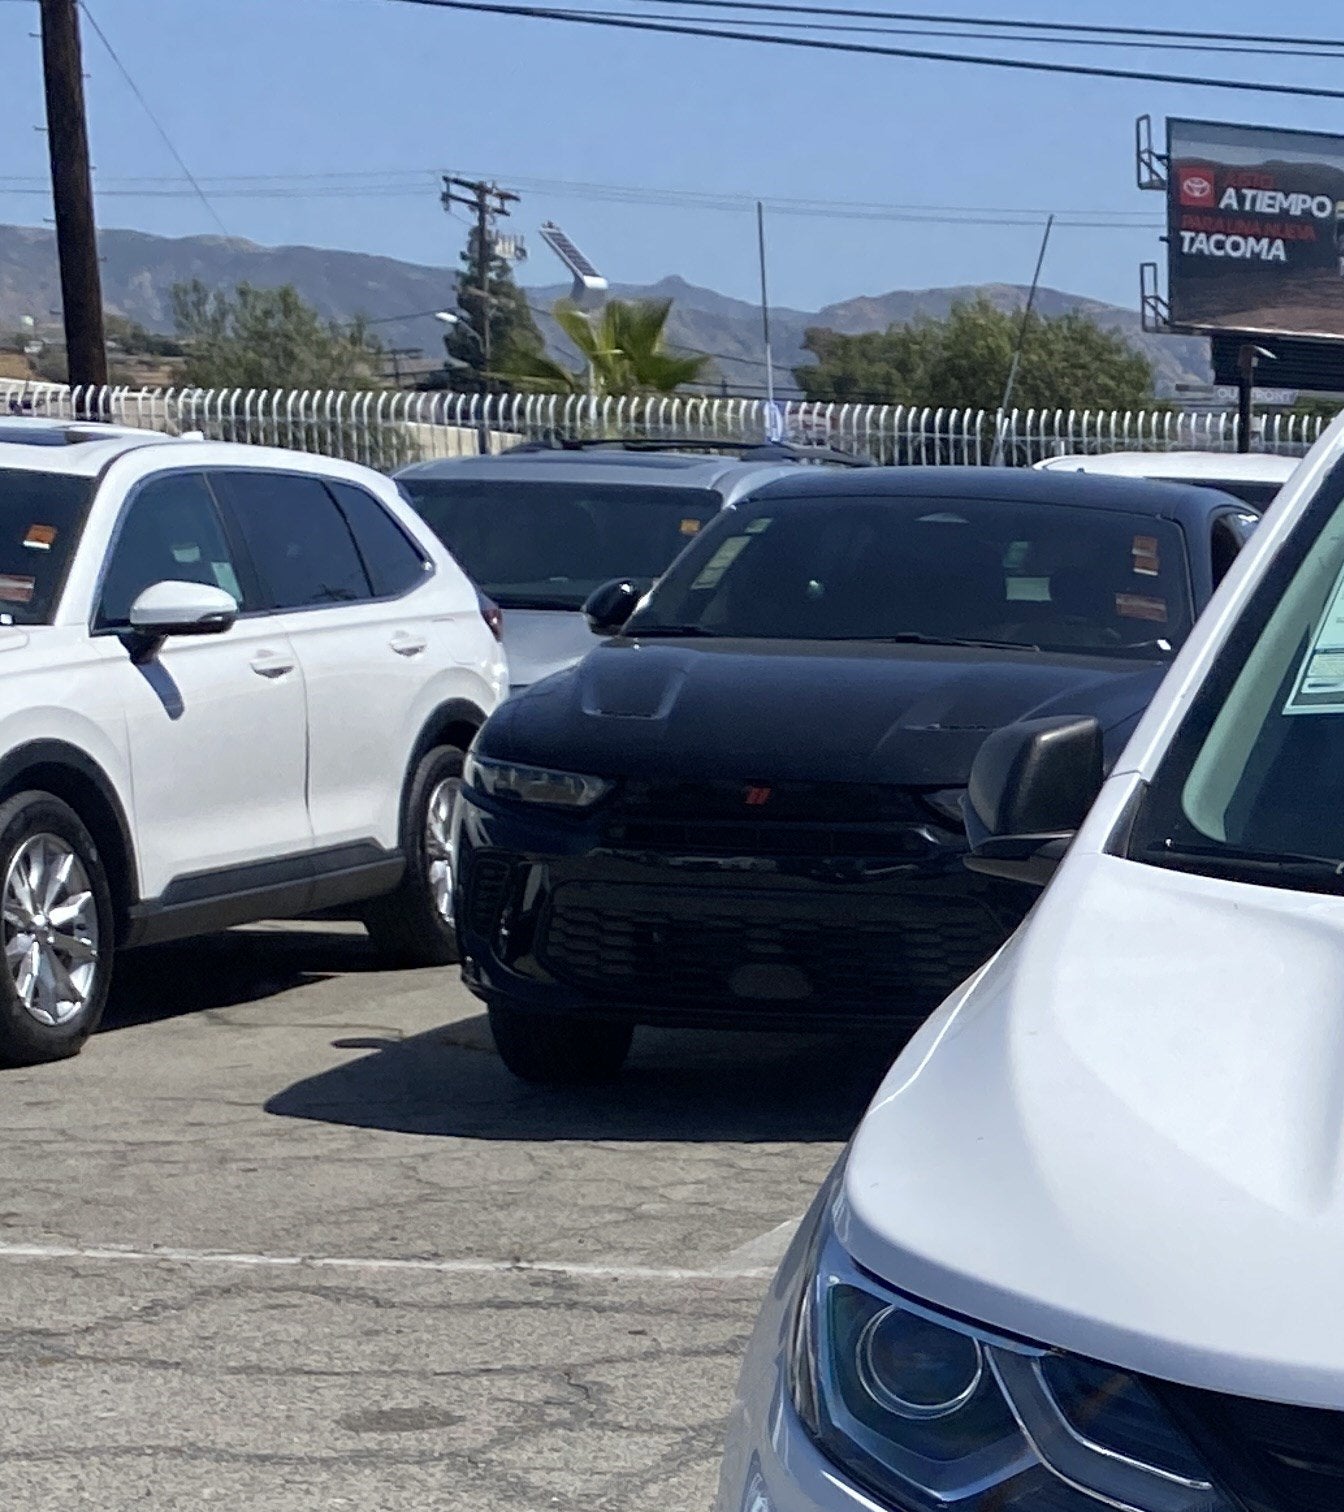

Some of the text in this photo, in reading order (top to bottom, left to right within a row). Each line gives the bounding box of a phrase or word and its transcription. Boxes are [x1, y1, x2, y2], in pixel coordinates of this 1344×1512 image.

[1219, 187, 1333, 218] A TIEMPO
[1180, 231, 1287, 261] TACOMA
